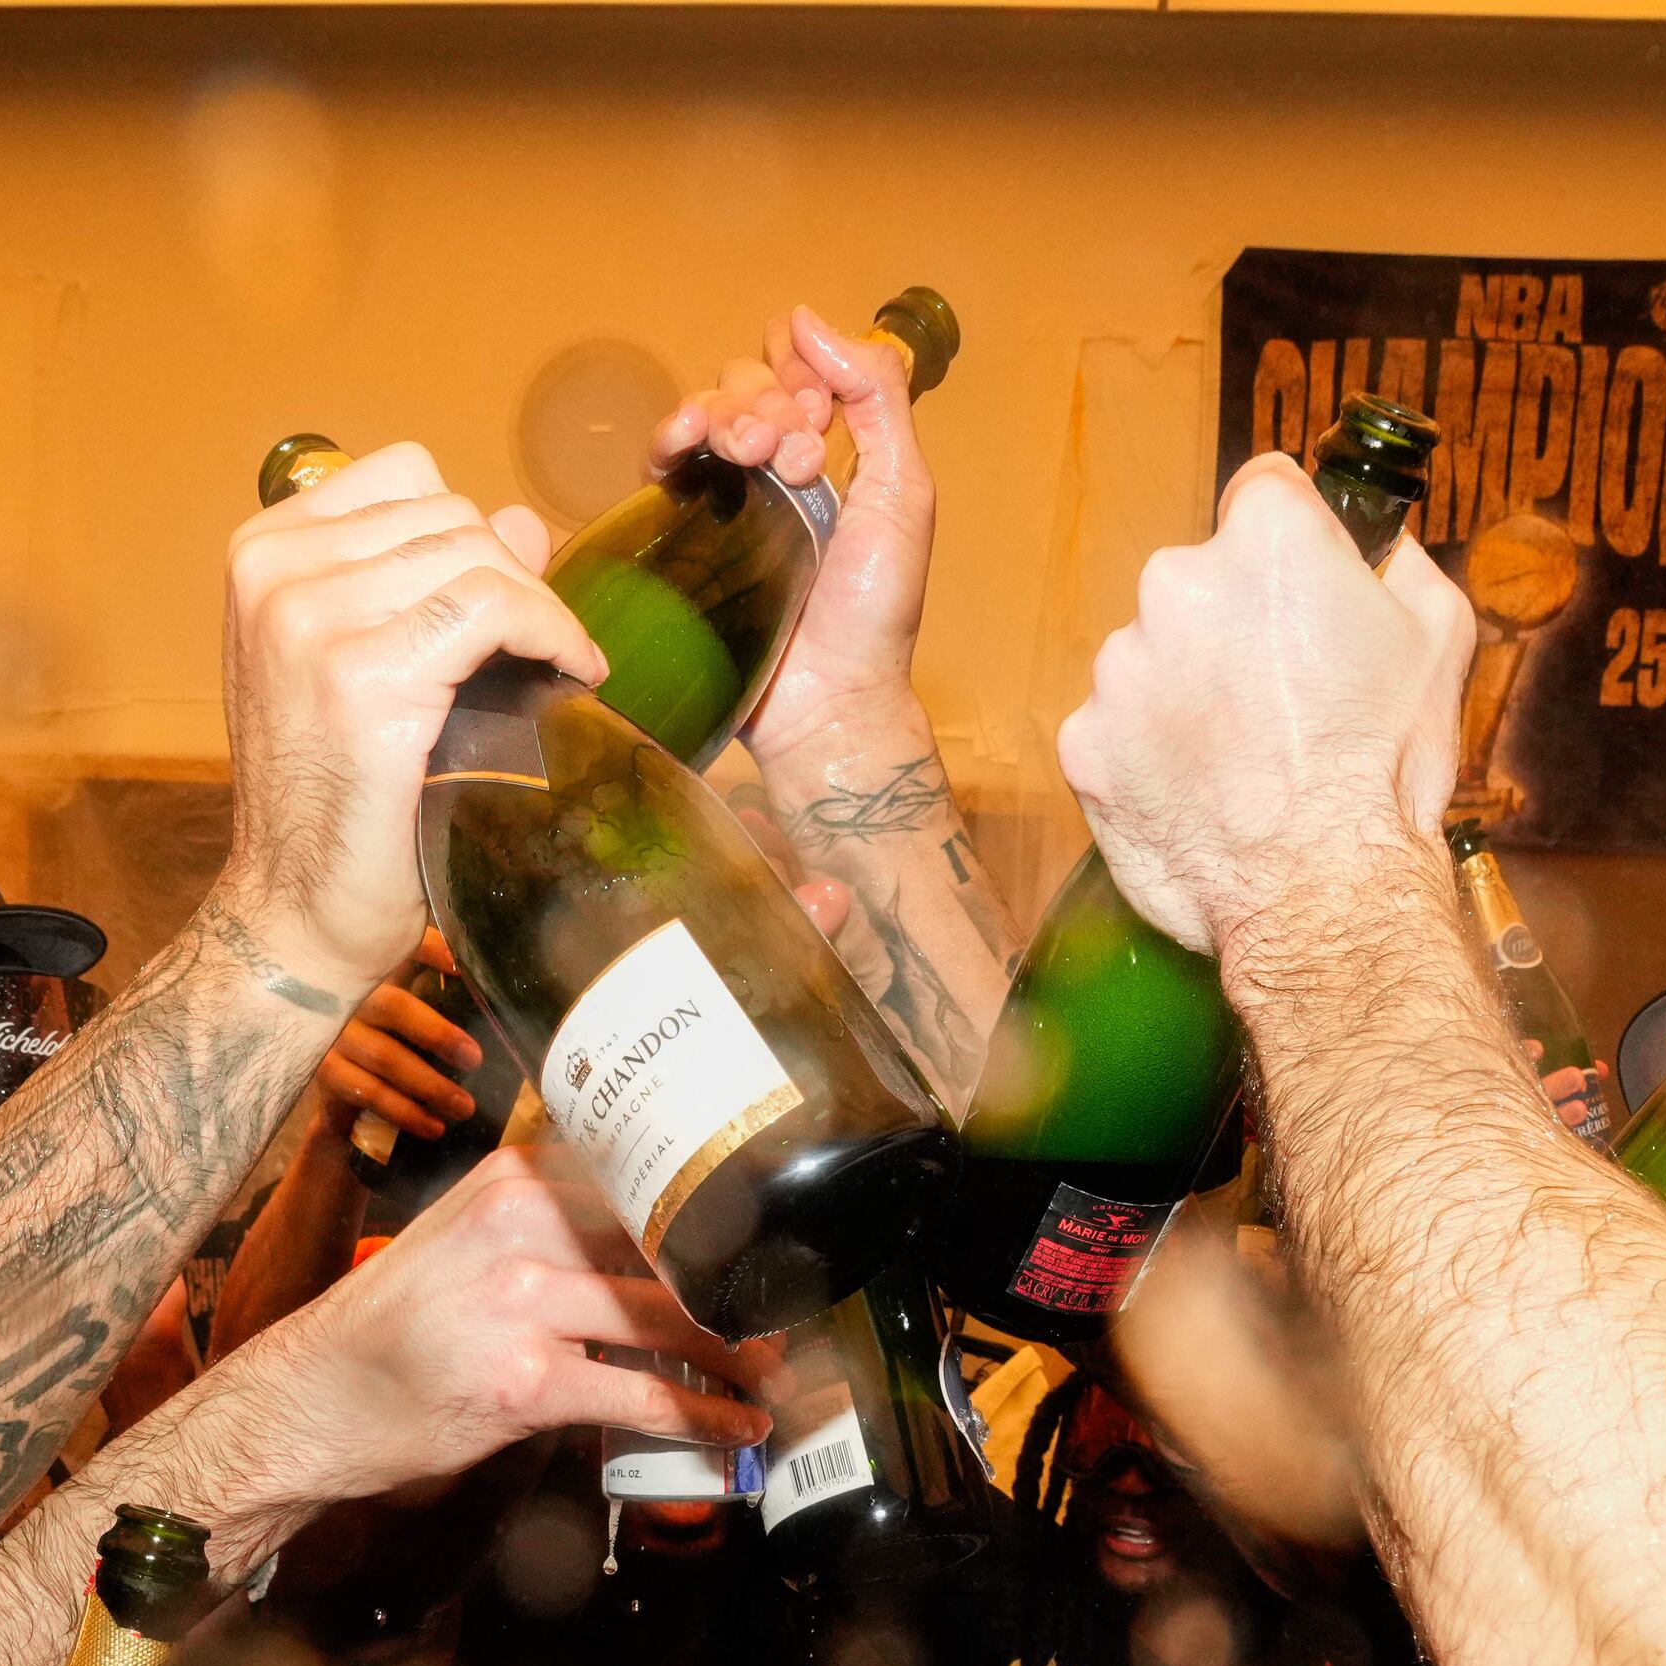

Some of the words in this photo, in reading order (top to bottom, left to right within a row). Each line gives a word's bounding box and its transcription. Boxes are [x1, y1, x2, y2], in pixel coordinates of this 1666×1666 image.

[1455, 273, 1584, 344] NBA
[591, 999, 703, 1121] CHANDON
[1058, 1218, 1105, 1243] MARIE
[1121, 1233, 1150, 1245] MOY
[1090, 1246, 1111, 1255] BRUT
[617, 1469, 627, 1479] FL.
[628, 1469, 643, 1480] OZ.
